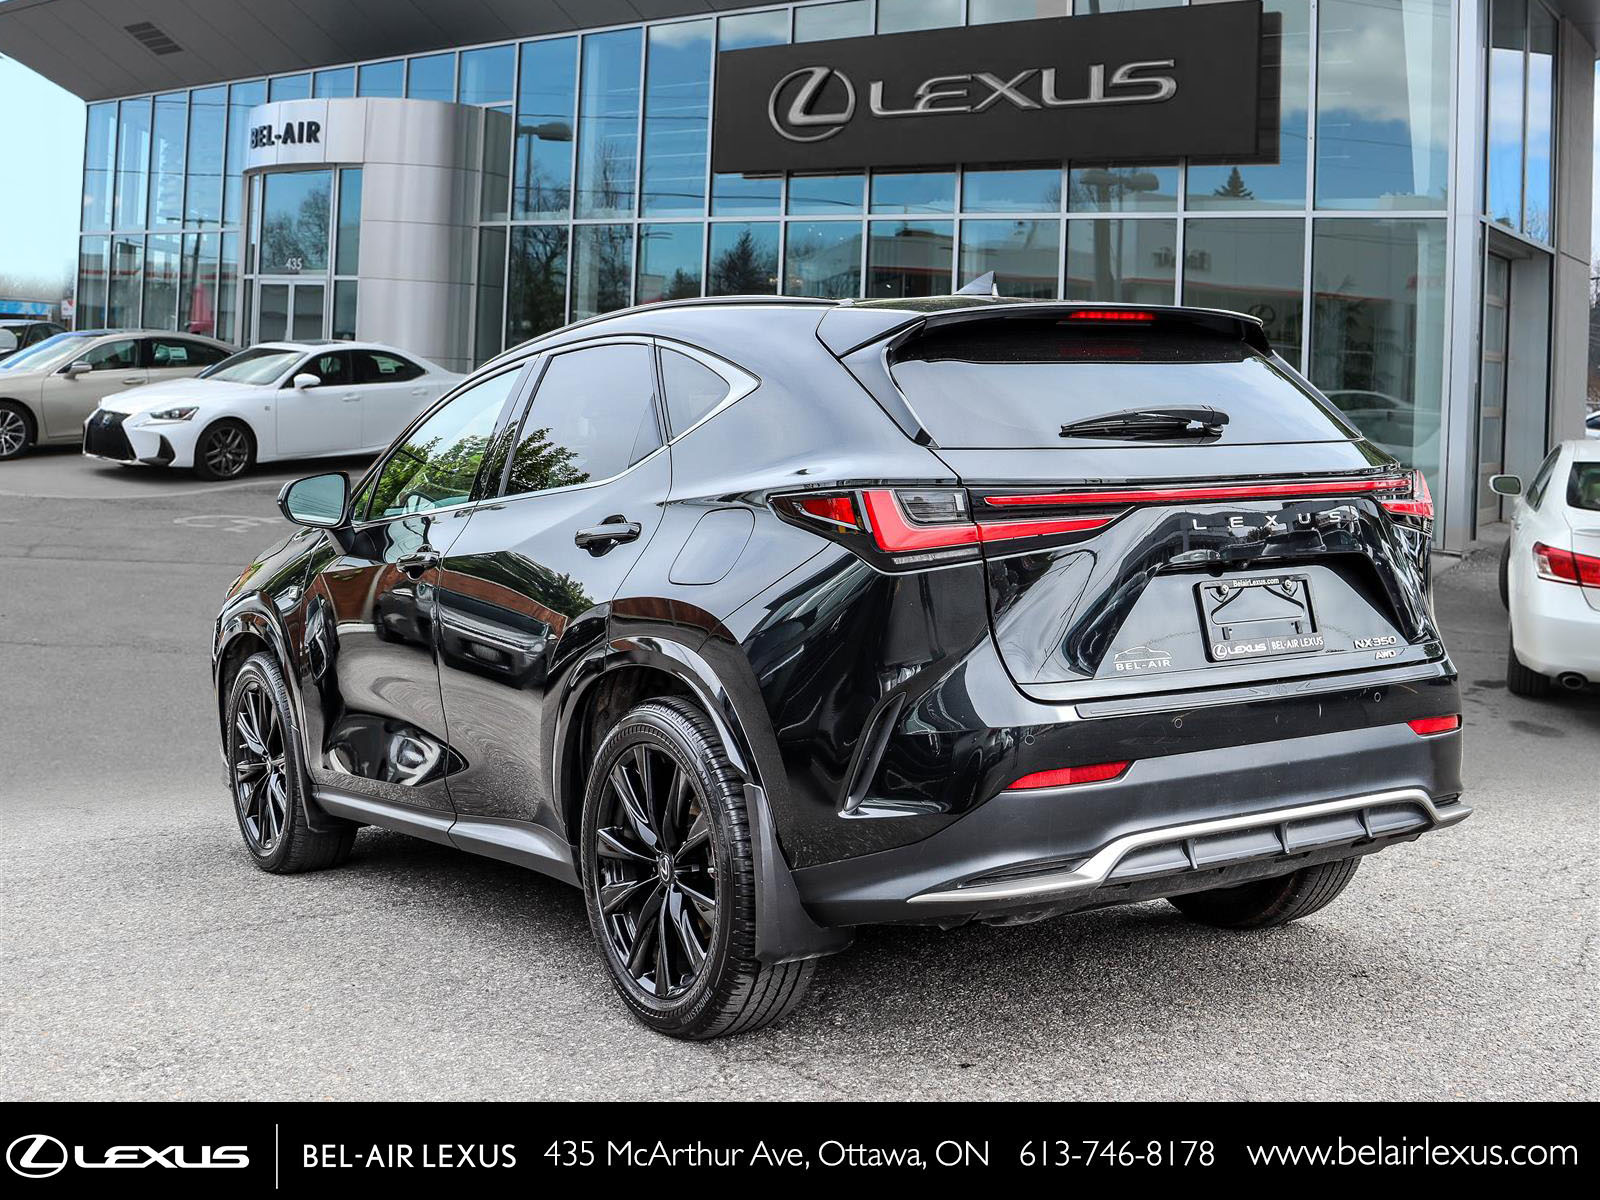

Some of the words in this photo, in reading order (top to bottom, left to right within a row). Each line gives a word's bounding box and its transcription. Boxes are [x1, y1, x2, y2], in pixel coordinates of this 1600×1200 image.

[869, 58, 1178, 118] LEXUS
[250, 121, 321, 149] BEL-AIR
[286, 257, 303, 270] 435
[1192, 511, 1342, 530] LEXUS
[1232, 578, 1280, 588] BelairLexus.com
[1228, 643, 1267, 655] LEXUS
[1271, 639, 1299, 651] BEL-AIR
[1300, 637, 1324, 648] LEXUS
[1375, 649, 1397, 660] AWD
[1115, 659, 1172, 671] BEL-AIR
